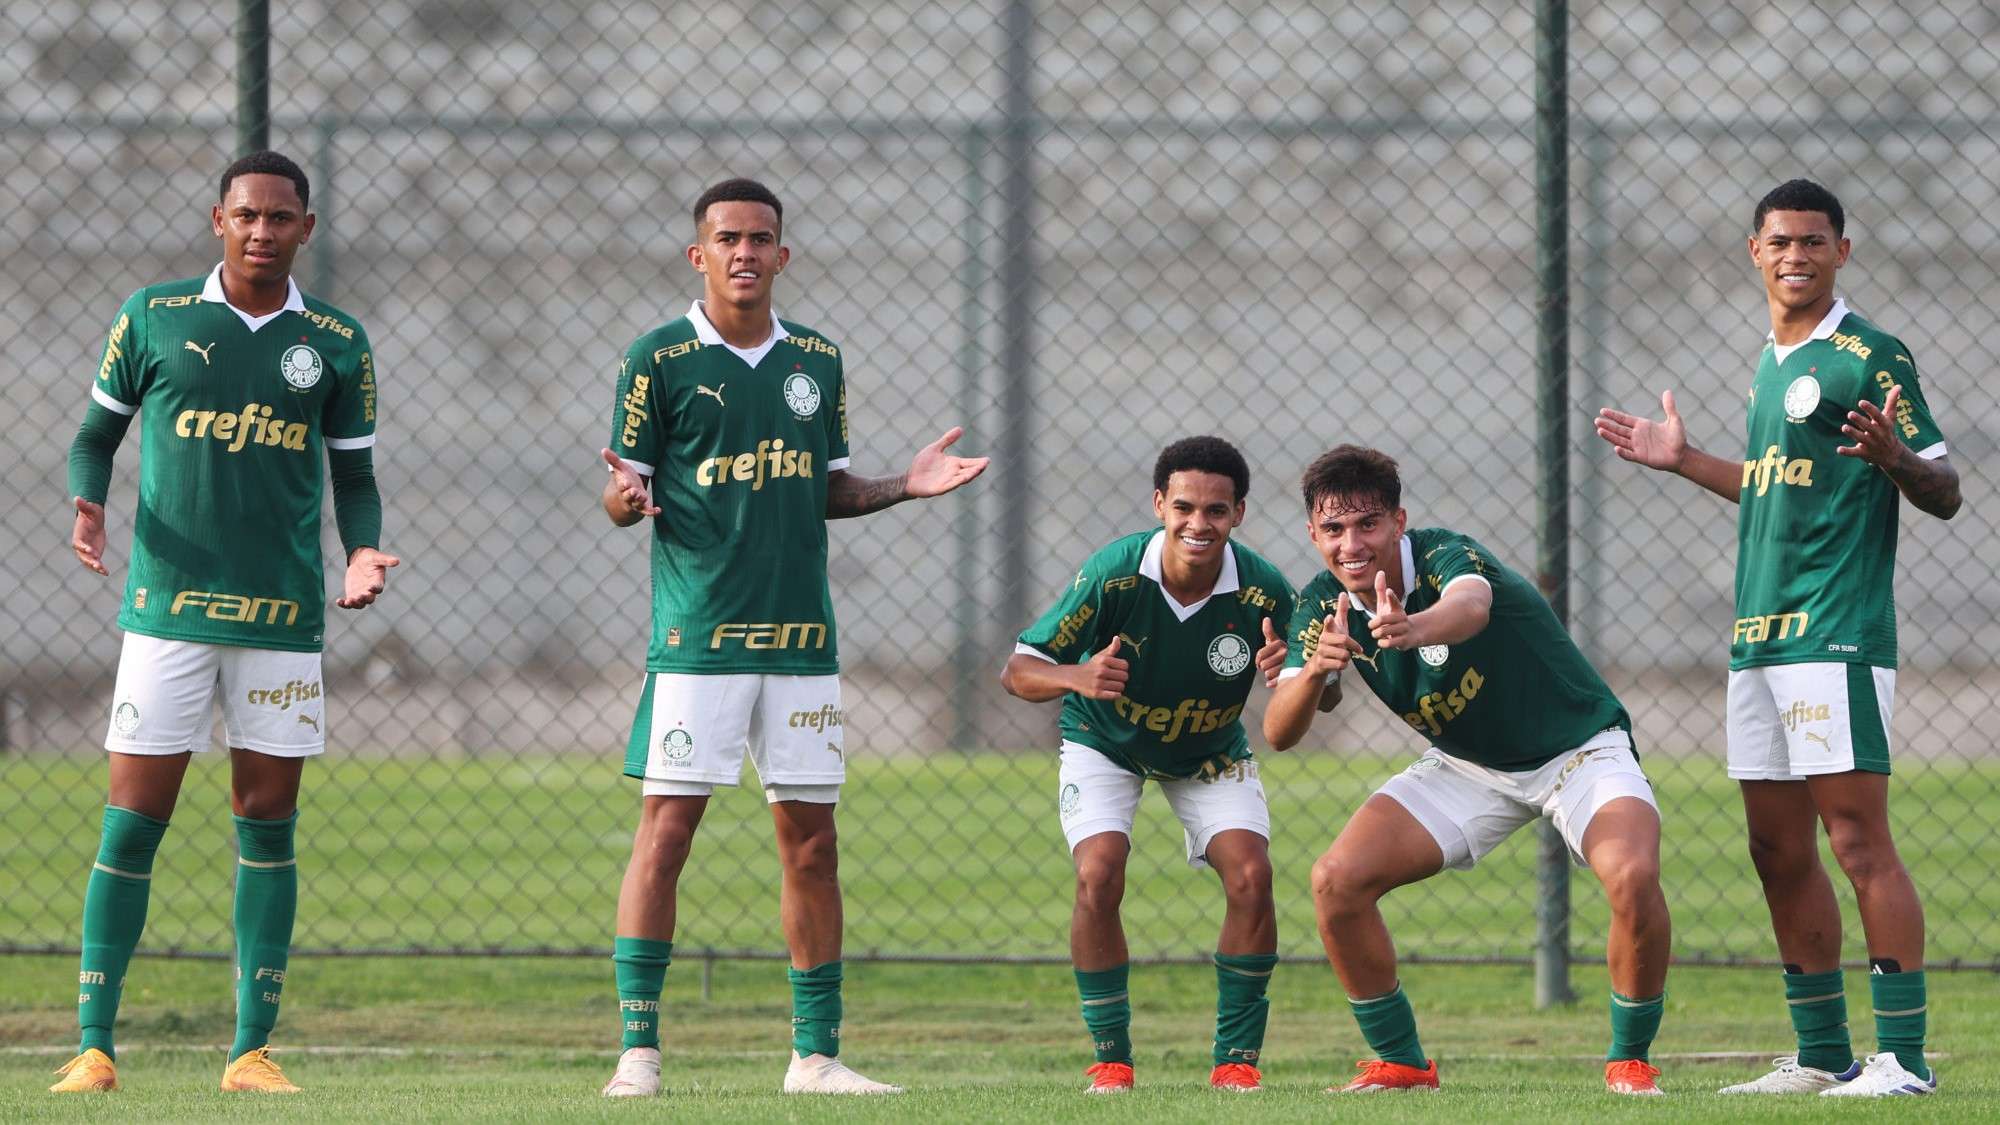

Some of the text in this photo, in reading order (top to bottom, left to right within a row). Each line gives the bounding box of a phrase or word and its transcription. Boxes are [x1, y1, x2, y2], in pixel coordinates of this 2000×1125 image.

[301, 310, 355, 340] refisa
[175, 403, 309, 452] crefisa
[621, 374, 650, 448] crefisa
[696, 438, 814, 491] crefisa
[1210, 651, 1248, 673] PALMEIRAS
[248, 681, 321, 710] crefisa
[1404, 667, 1485, 736] efisa
